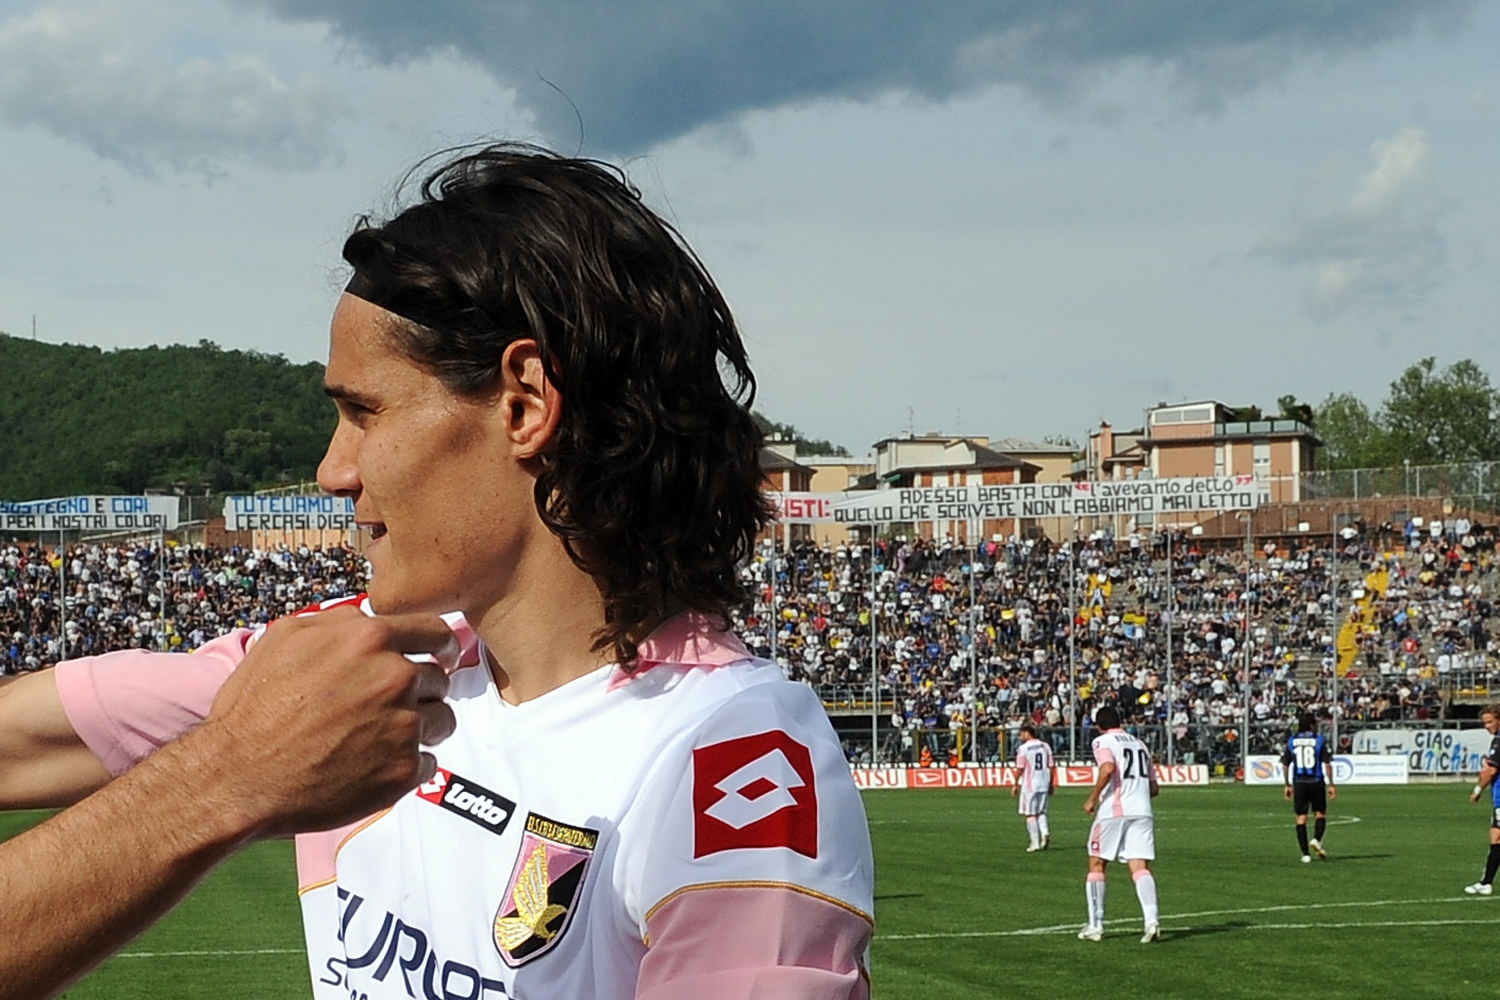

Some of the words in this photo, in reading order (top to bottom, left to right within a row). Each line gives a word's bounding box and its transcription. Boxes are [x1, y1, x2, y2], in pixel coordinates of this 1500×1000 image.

[900, 488, 968, 506] ADESSO
[978, 486, 1036, 503] BASTA
[1041, 484, 1072, 501] CON
[95, 496, 106, 513] E
[111, 496, 149, 514] CORI
[231, 497, 334, 513] TUTELIAMO
[834, 506, 893, 522] QUELLO
[900, 505, 930, 520] CHE
[937, 502, 1015, 519] SCRIVETE
[1023, 500, 1059, 517] NON
[1061, 495, 1154, 515] L'ABBIAMO
[1162, 494, 1193, 511] MAI
[1199, 492, 1252, 509] LETTO
[7, 514, 36, 529] PER
[41, 514, 46, 529] I
[53, 514, 108, 529] NOSTRI
[114, 514, 168, 529] COLORI
[236, 514, 310, 530] CERCASI
[1414, 732, 1453, 749] CIAO
[1034, 752, 1043, 771] 9
[1123, 748, 1149, 779] 20
[1293, 745, 1316, 769] 18
